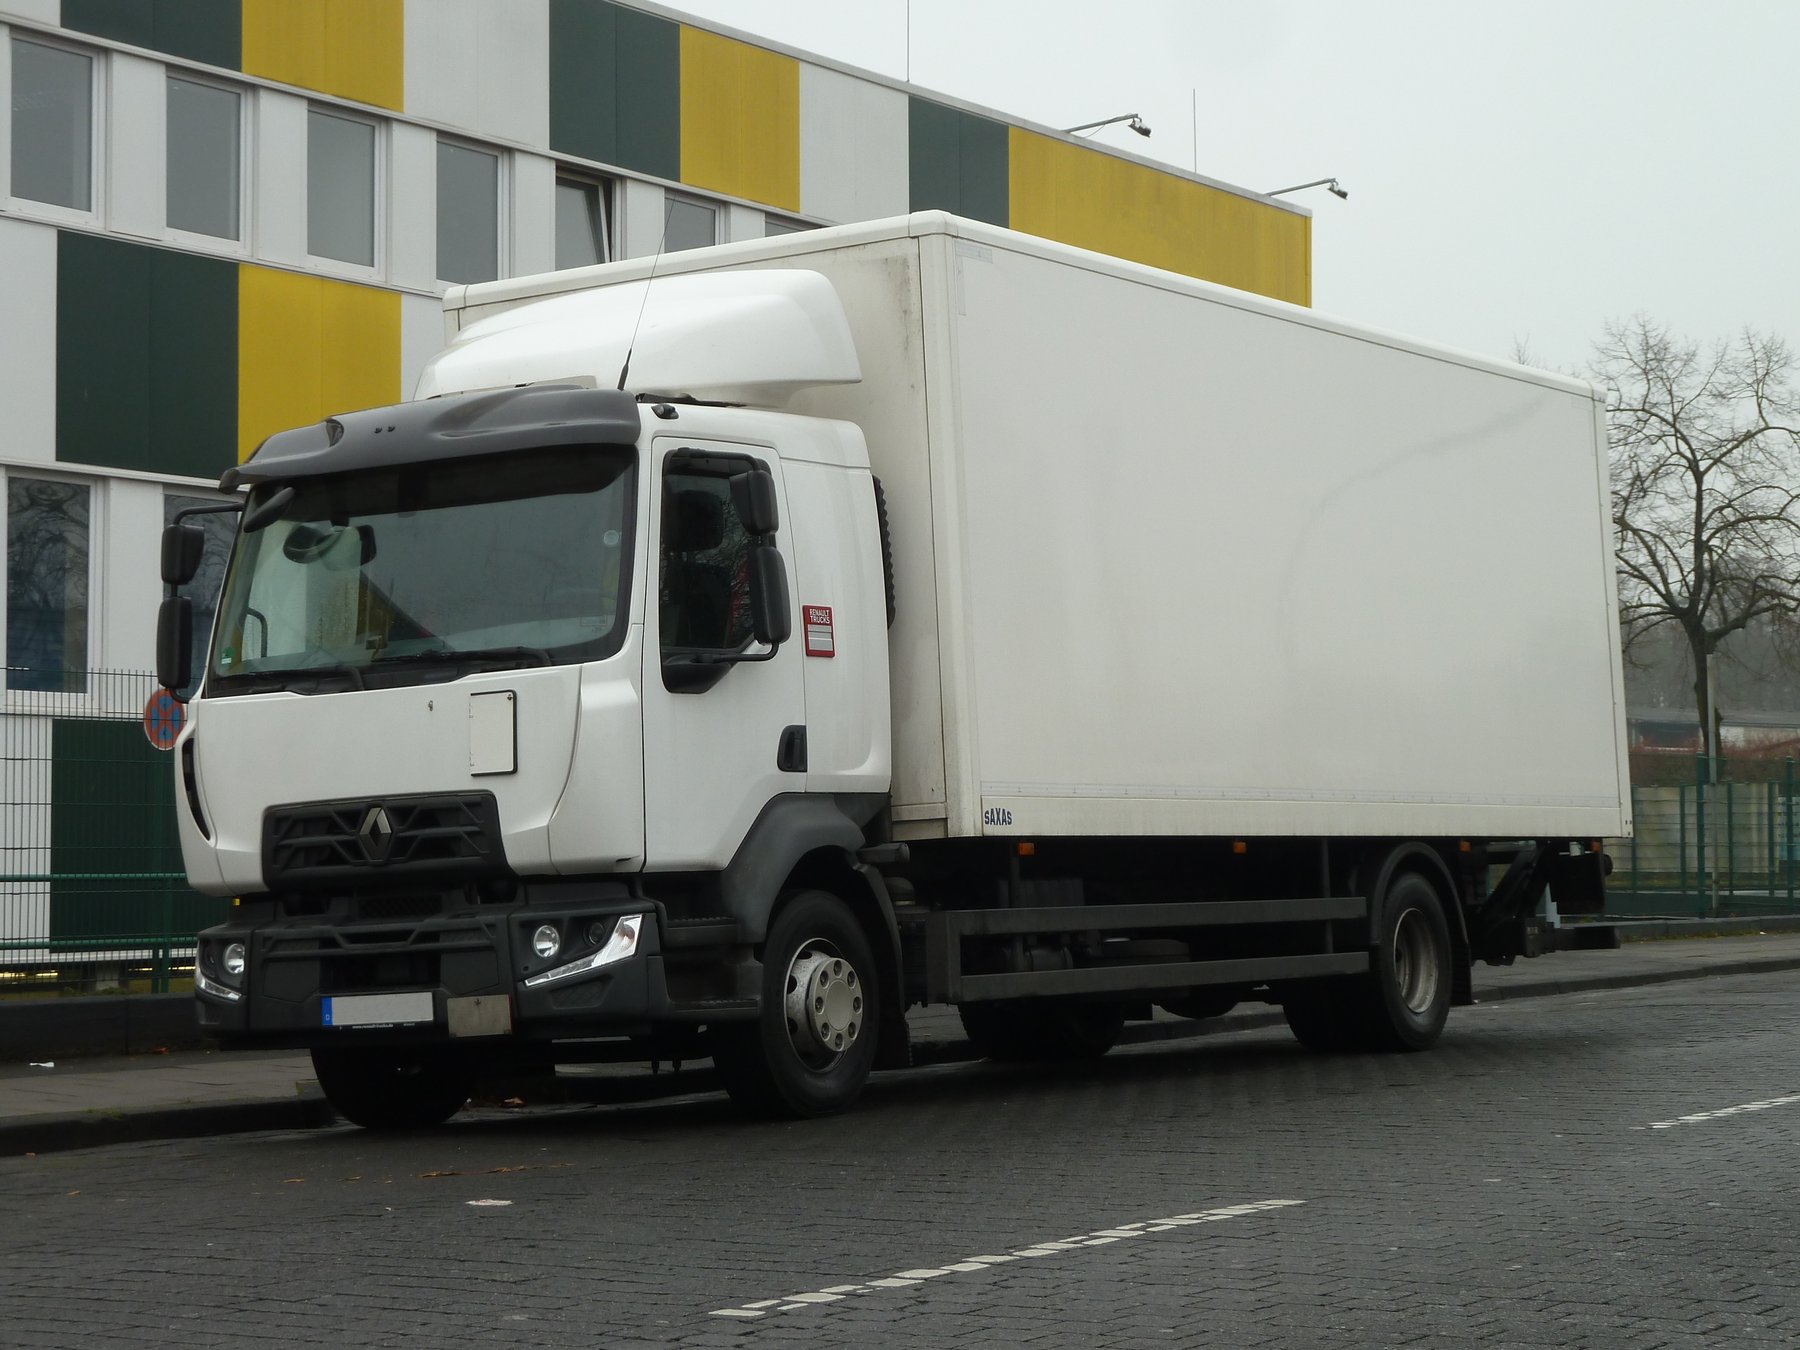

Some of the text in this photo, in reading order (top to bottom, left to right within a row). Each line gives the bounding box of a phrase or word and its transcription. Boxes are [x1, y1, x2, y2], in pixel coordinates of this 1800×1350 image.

[809, 608, 829, 616] RENAULT
[810, 616, 830, 624] TRUCKS
[984, 808, 1013, 826] SAXAS
